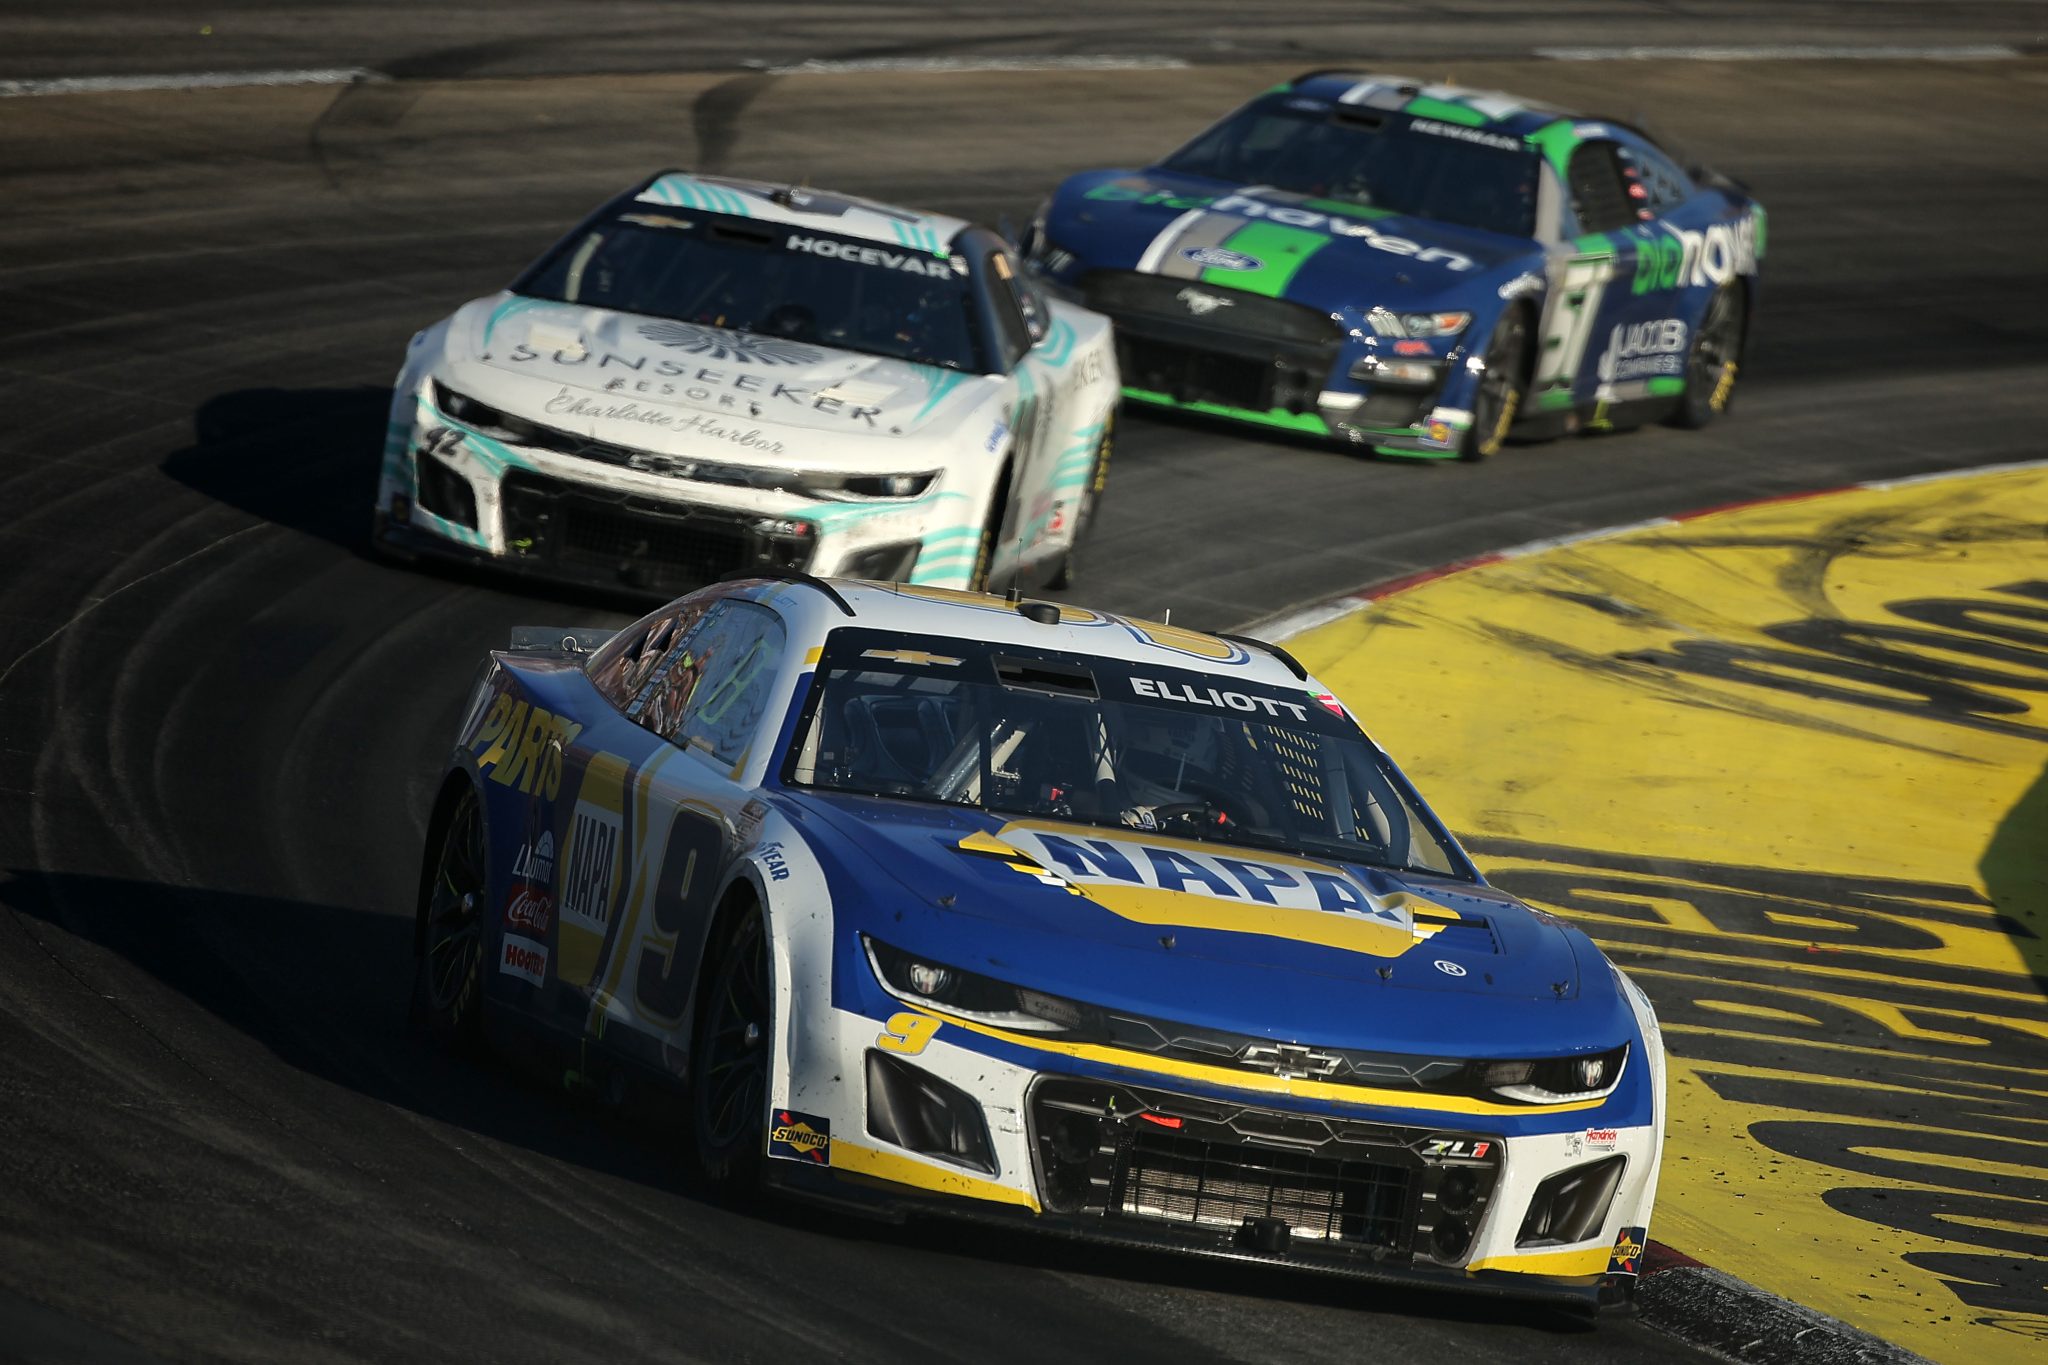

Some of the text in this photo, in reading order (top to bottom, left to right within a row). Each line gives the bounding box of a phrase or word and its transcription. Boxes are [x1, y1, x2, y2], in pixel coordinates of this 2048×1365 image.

[786, 234, 952, 280] HOCEVAR
[510, 342, 883, 428] SUNSEEKER
[604, 376, 763, 417] RESORT
[426, 427, 466, 456] 42
[544, 384, 786, 457] Charlotte Harbor
[1129, 677, 1308, 722] ELLIOTT
[468, 692, 583, 801] PARTS
[564, 813, 617, 924] NAPA
[1033, 832, 1404, 924] NAPA
[634, 804, 724, 1030] 9
[505, 943, 546, 977] HOOTERS
[876, 1012, 943, 1056] 9
[775, 1128, 826, 1148] SUNOCO
[1421, 1139, 1489, 1157] ZL1
[1585, 1128, 1618, 1144] Hendrick
[1613, 1245, 1639, 1259] SUNOCO
